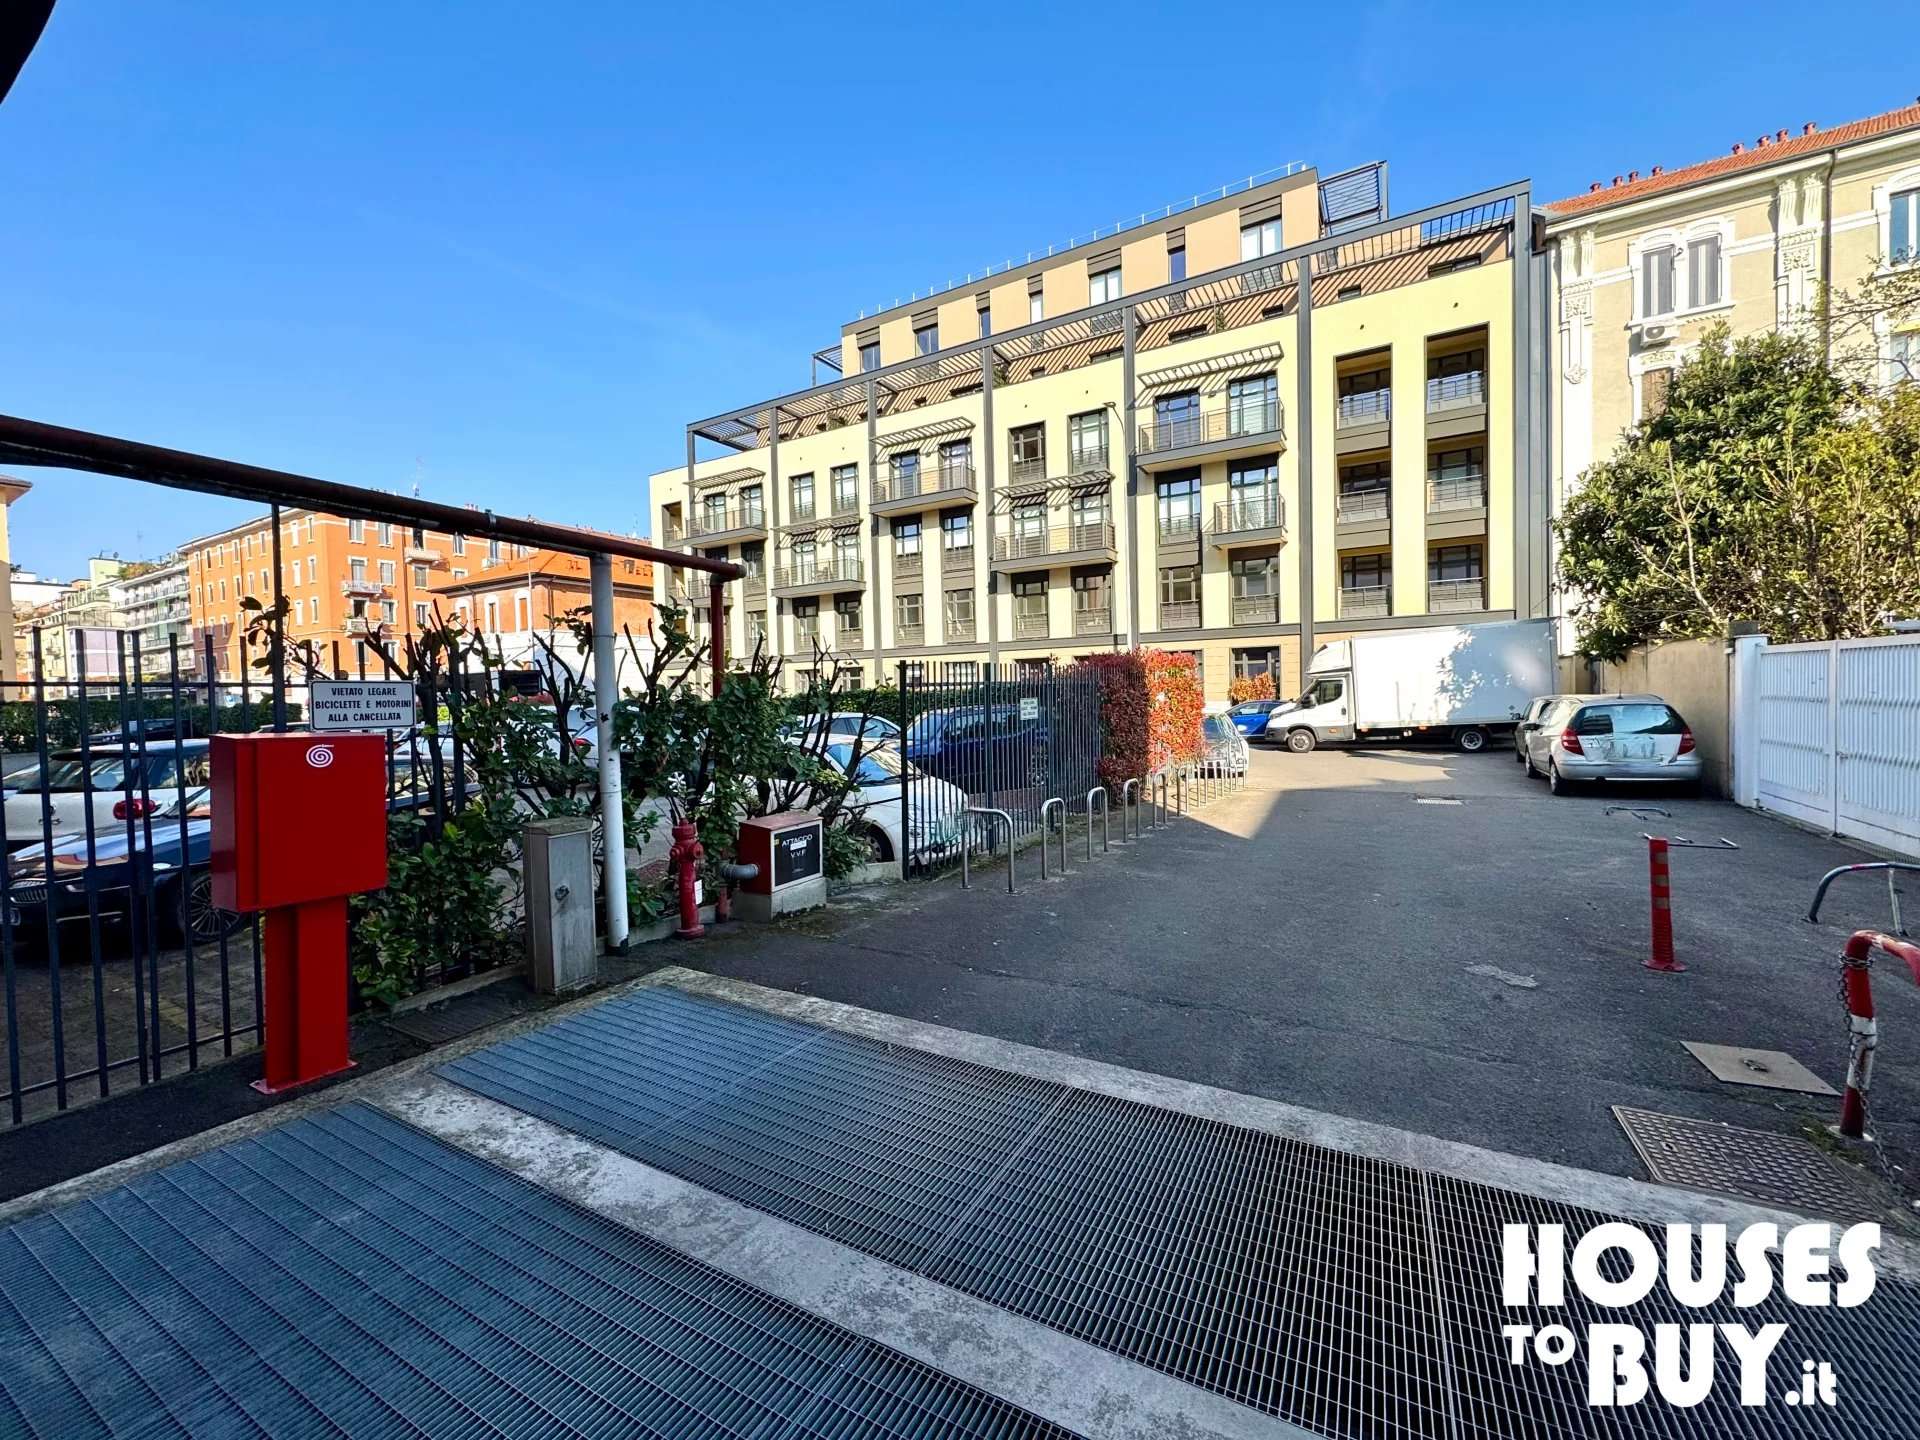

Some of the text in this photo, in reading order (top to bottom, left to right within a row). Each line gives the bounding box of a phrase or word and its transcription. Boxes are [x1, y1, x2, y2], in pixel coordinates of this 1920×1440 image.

[331, 687, 397, 696] VIETATO LEGARE
[315, 700, 411, 709] BICICLETTE E MOTORINI
[328, 712, 401, 722] ALLA CANCELLATA
[781, 833, 813, 848] ATTACCO
